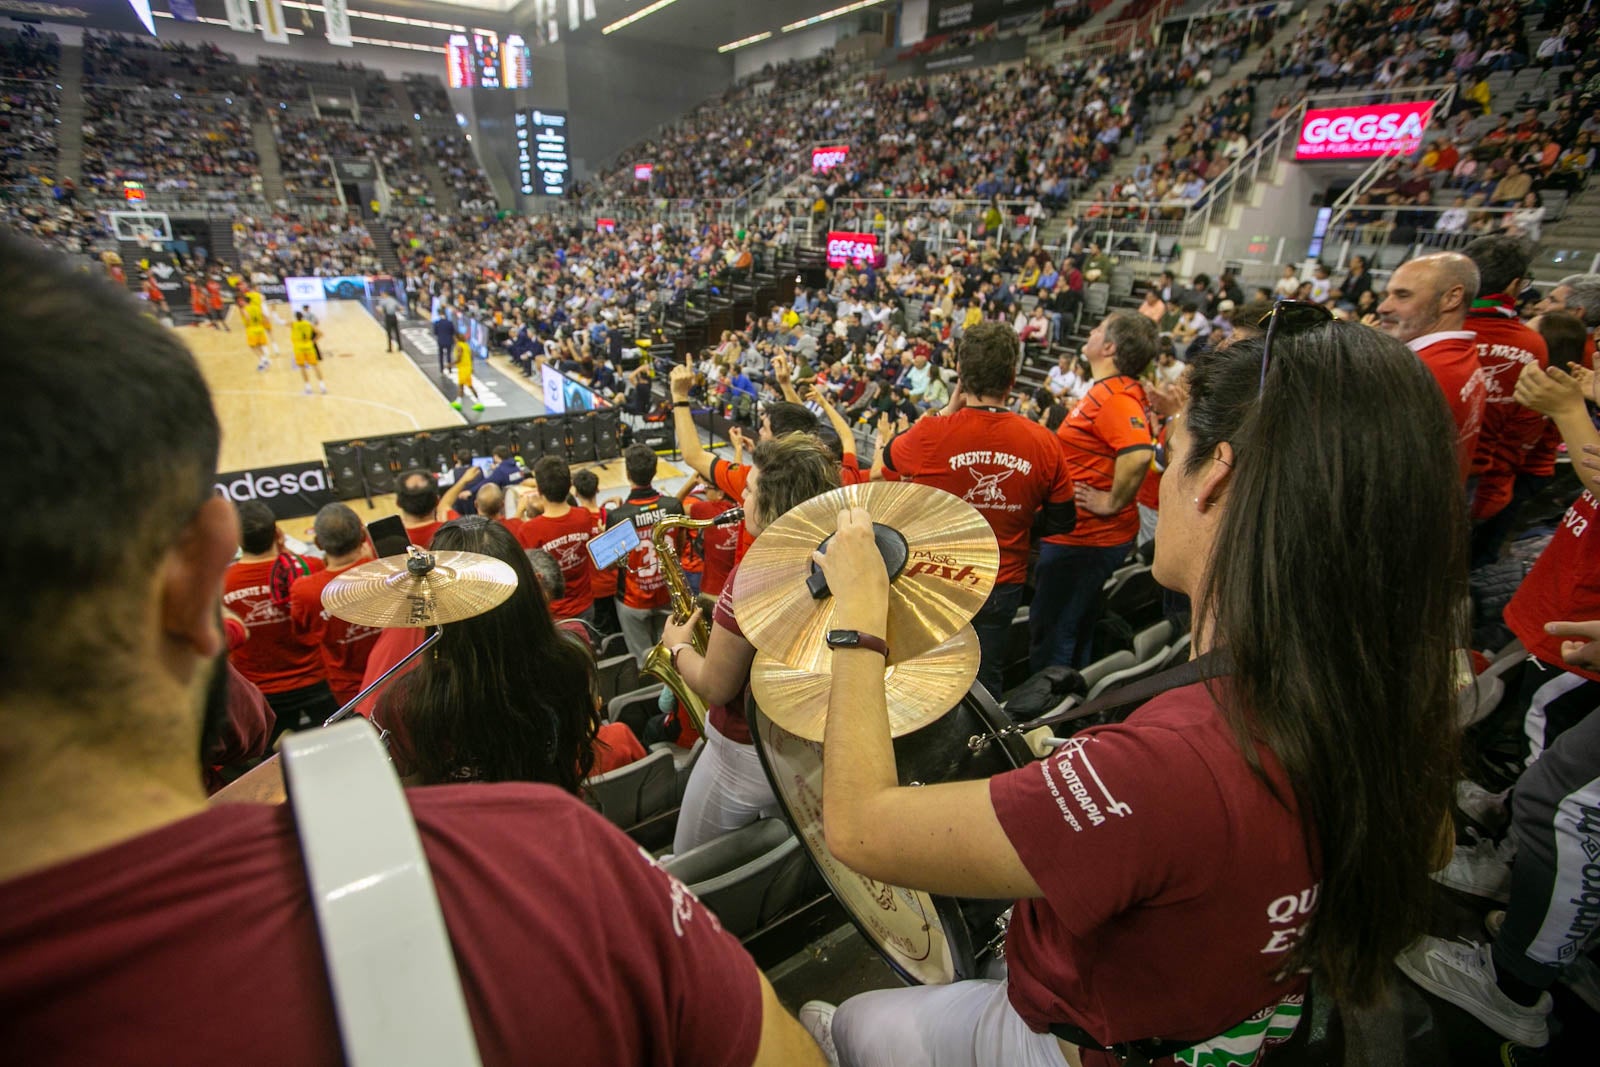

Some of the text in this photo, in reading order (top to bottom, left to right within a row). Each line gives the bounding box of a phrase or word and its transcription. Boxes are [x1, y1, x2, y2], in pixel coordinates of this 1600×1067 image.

[949, 451, 992, 471] FRENTE
[1056, 796, 1083, 832] Burgos
[1564, 863, 1600, 940] umbro
